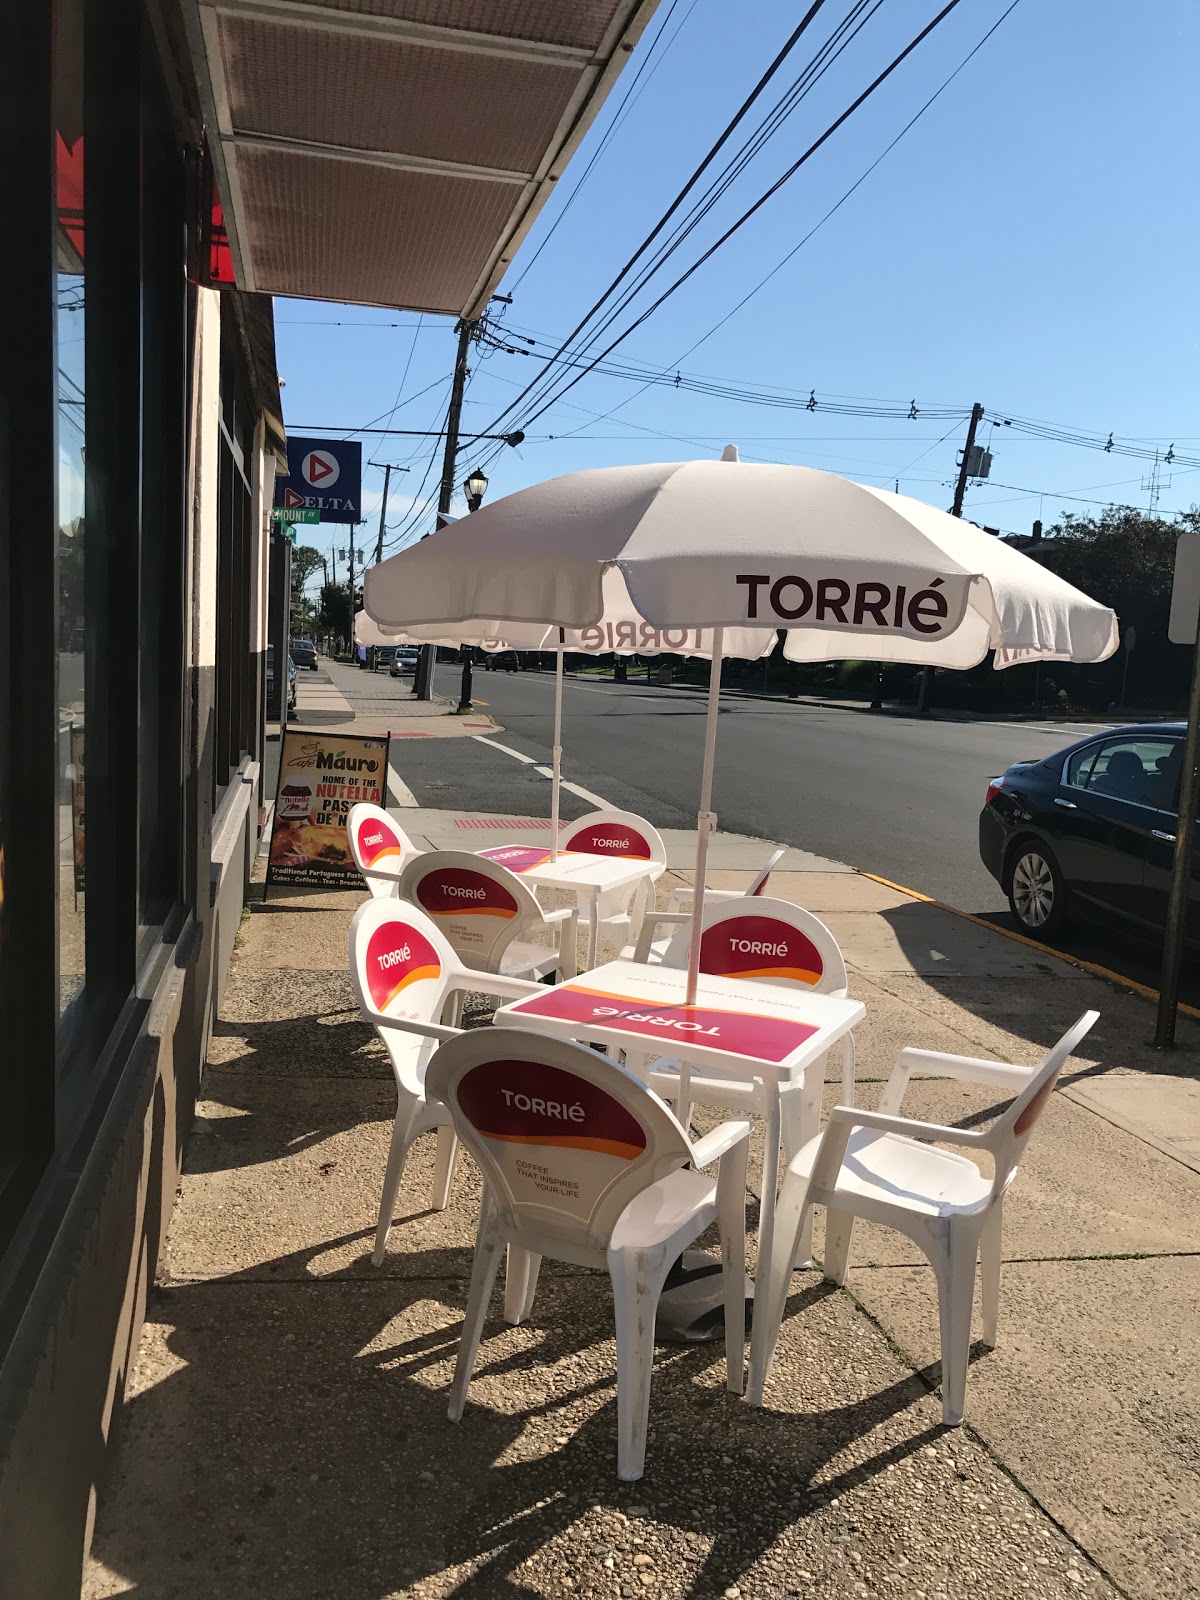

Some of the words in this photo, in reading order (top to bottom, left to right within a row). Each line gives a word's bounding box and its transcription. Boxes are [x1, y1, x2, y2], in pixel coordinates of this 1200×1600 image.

[735, 574, 949, 634] TORRIé
[322, 775, 346, 785] HOME
[348, 778, 360, 786] OF
[363, 779, 377, 788] THE
[316, 784, 381, 802] NUTELLA
[316, 812, 333, 825] DE
[338, 814, 348, 826] N
[364, 832, 384, 847] TORRIé
[591, 837, 630, 849] TORRIé
[271, 866, 308, 875] Traditional
[309, 869, 345, 879] Portuguese
[347, 871, 364, 879] Pastr
[294, 876, 318, 884] Coffees
[440, 884, 487, 900] TORRIé
[377, 942, 412, 971] TORRIé
[728, 938, 789, 958] TORRIé
[592, 1006, 721, 1037] TORRIé
[500, 1088, 586, 1123] TORRIé
[515, 1159, 549, 1175] COFFEE
[516, 1167, 538, 1180] THAT
[540, 1175, 579, 1190] INSPIRES
[534, 1181, 559, 1194] YOUR
[560, 1189, 580, 1199] LIFE
